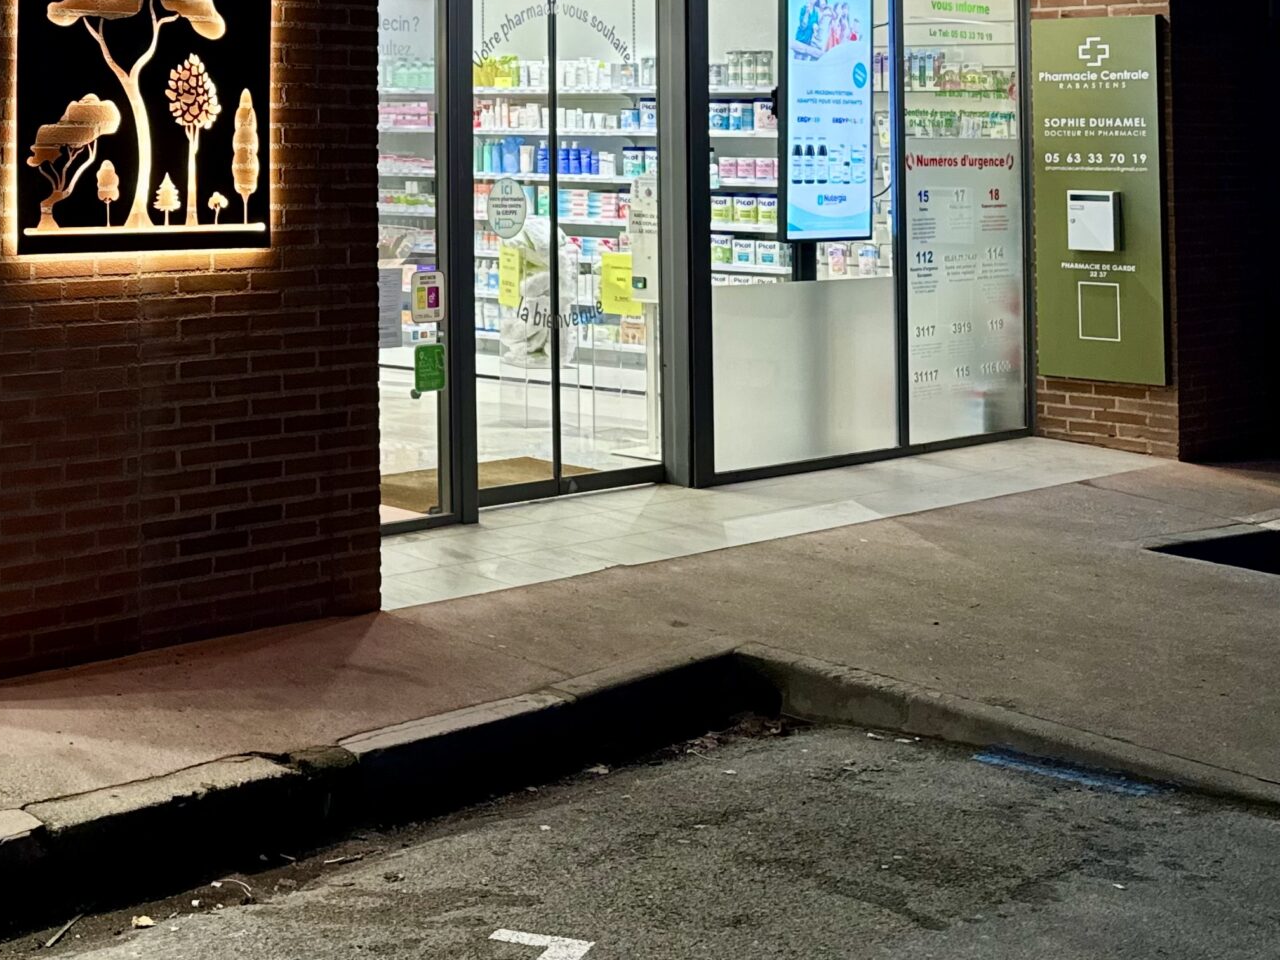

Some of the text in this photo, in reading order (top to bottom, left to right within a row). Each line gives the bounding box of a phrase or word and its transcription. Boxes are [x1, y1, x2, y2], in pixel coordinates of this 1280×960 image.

[931, 0, 990, 14] vous informe
[472, 30, 502, 69] Votre
[562, 3, 589, 23] vous
[590, 15, 631, 64] souhaite
[1039, 70, 1149, 81] Pharmacie Centrale
[1044, 118, 1146, 127] SOPHIE DUHAMEL
[960, 154, 1005, 170] d'urgence
[1045, 153, 1147, 164] 05 63 33 70 19
[918, 190, 929, 203] 15
[954, 189, 965, 202] 17
[989, 188, 1000, 200] 18
[916, 250, 933, 264] 112
[987, 247, 1004, 260] 114
[1061, 262, 1100, 271] PHARMACIE
[1112, 264, 1136, 272] GARDE
[517, 296, 529, 323] la
[952, 322, 972, 334] 3919
[989, 319, 1004, 330] 119
[915, 325, 936, 338] 3117
[914, 369, 938, 383] 31117
[956, 366, 970, 378] 115
